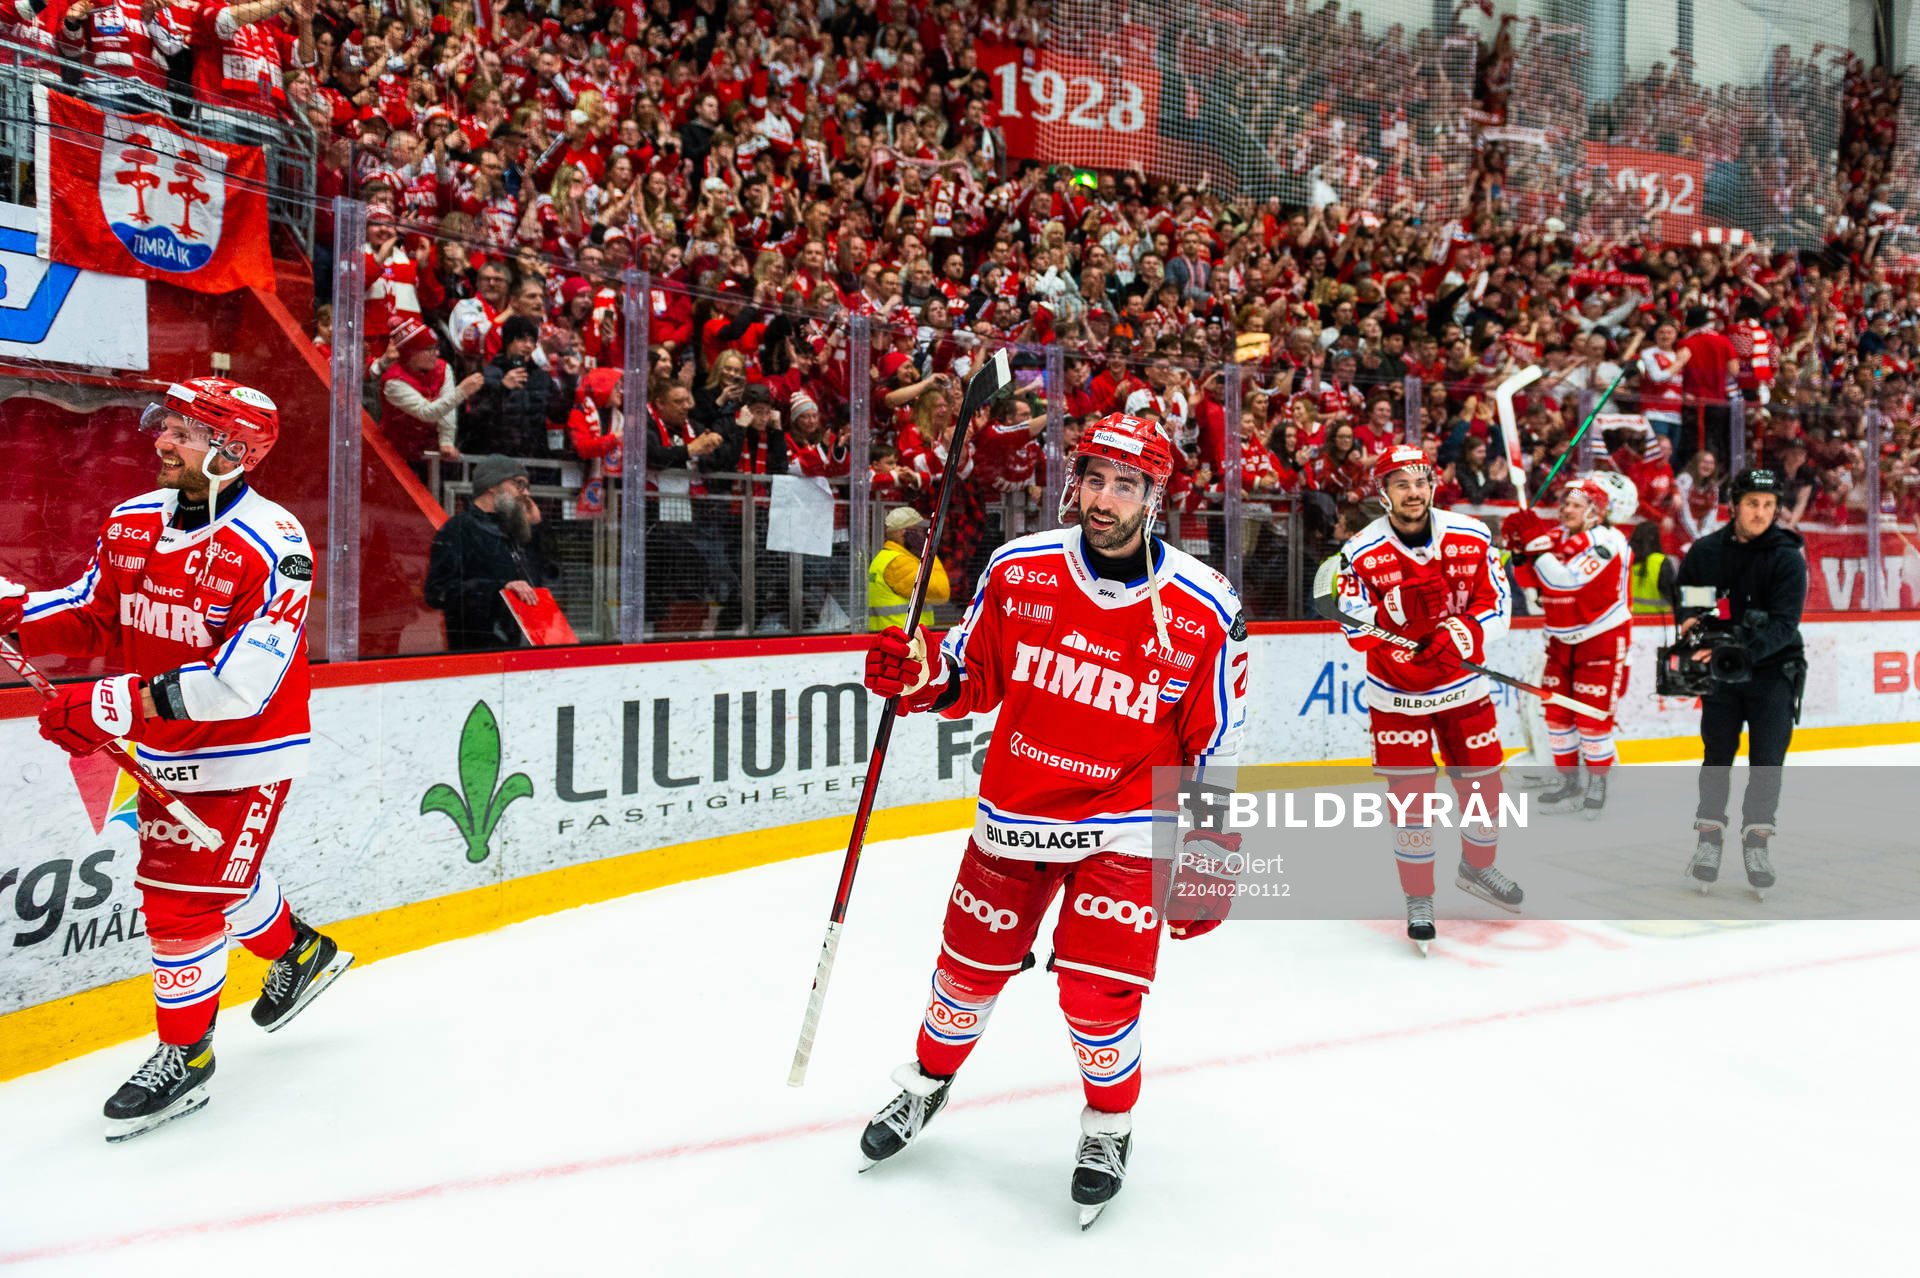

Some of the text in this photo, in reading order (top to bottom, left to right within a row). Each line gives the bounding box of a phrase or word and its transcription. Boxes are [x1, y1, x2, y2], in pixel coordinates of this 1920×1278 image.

[993, 62, 1146, 132] 1928
[133, 234, 190, 266] TIMRÅ IK
[122, 527, 150, 542] SCA
[218, 549, 243, 567] SCA
[1377, 553, 1398, 565] SCA
[1459, 545, 1480, 554] SCA
[114, 554, 146, 570] LILIUM
[184, 550, 202, 575] C
[154, 584, 184, 598] NHC
[202, 571, 234, 595] LILIUM
[1026, 570, 1059, 588] SCA
[1098, 588, 1117, 599] SHL
[266, 588, 308, 633] 44
[1018, 601, 1053, 621] LILIUM
[1174, 616, 1206, 639] SCA
[1359, 624, 1419, 650] BAUER
[1085, 644, 1121, 662] NHC
[1158, 645, 1195, 670] LILIUM
[1011, 640, 1160, 724] TIMRÅ
[1393, 689, 1467, 709] BILBOLAGET
[555, 682, 869, 802] LILIUM
[1377, 729, 1428, 748] coop
[1466, 727, 1498, 749] coo
[1020, 741, 1121, 781] consembly
[559, 775, 868, 835] FASTIGHETER
[230, 781, 281, 864] PEA
[986, 823, 1104, 849] BILBOLAGET
[952, 881, 1019, 933] coop
[1074, 892, 1158, 934] coop
[62, 903, 145, 957] MÅL
